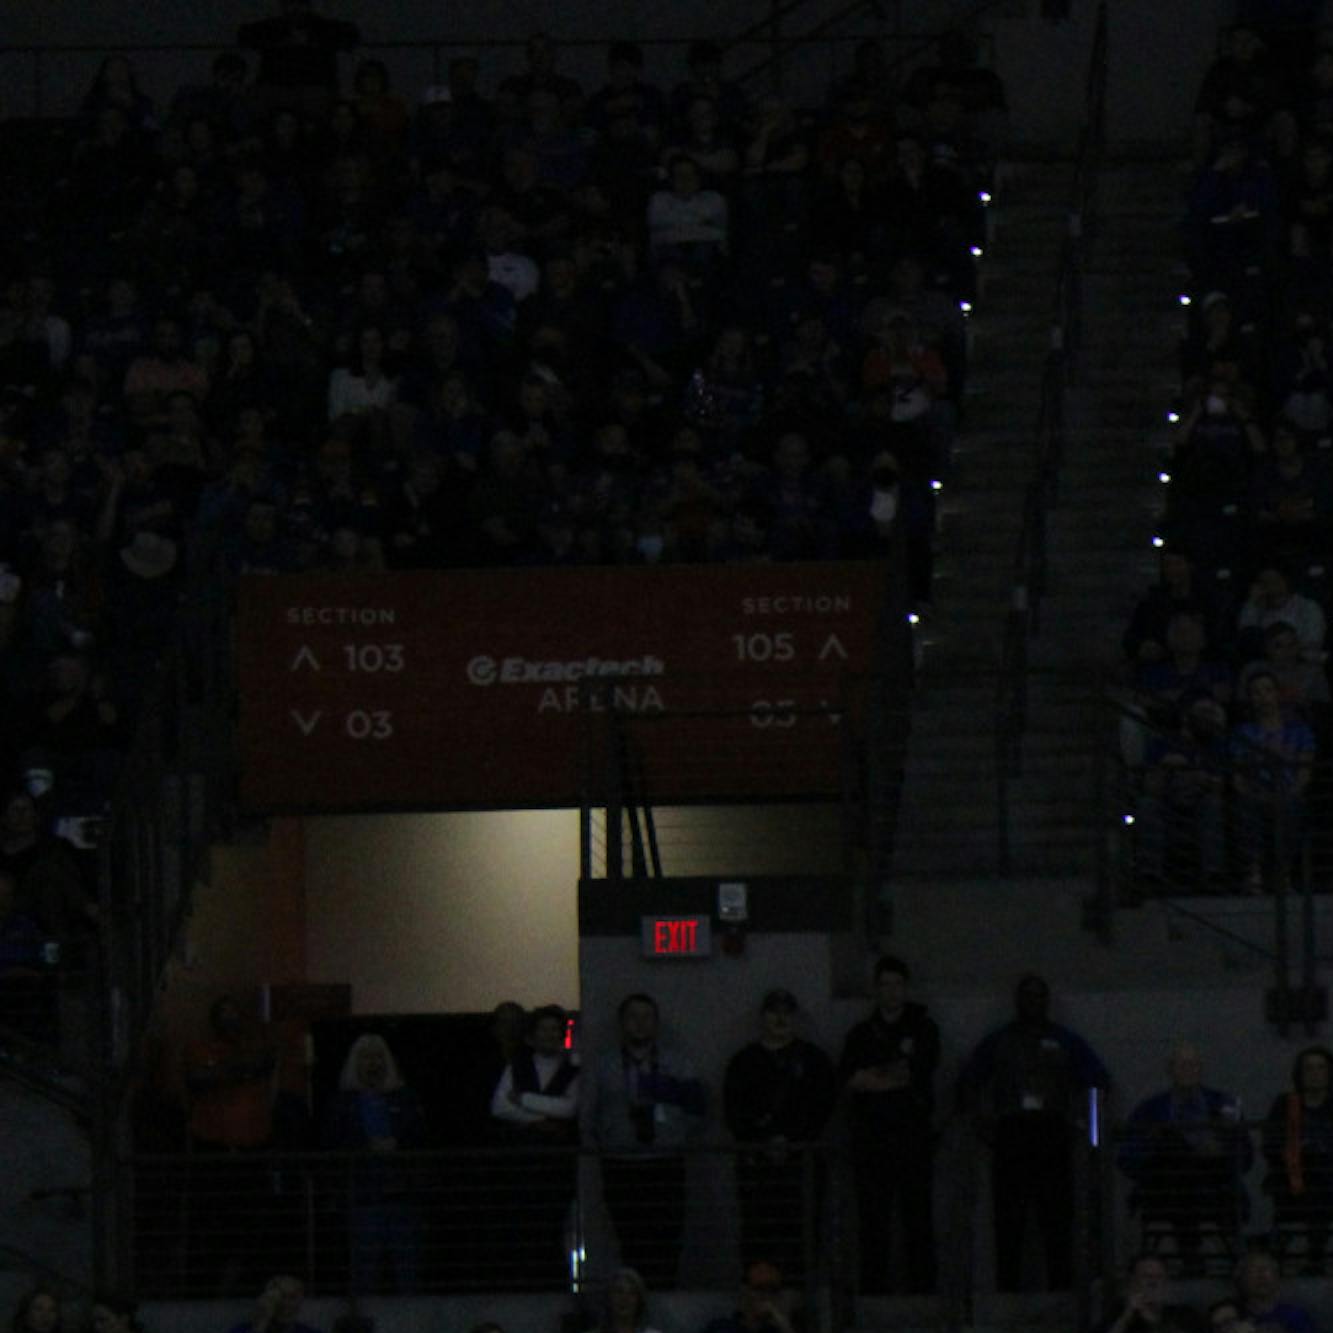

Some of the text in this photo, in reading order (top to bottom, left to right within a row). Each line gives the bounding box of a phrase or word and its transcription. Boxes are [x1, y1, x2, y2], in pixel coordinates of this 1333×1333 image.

[286, 607, 397, 625] SECTION
[742, 596, 852, 615] SECTION
[343, 643, 406, 673] 103
[732, 632, 797, 663] 105
[346, 708, 394, 739] 03
[655, 920, 698, 953] EXIT
